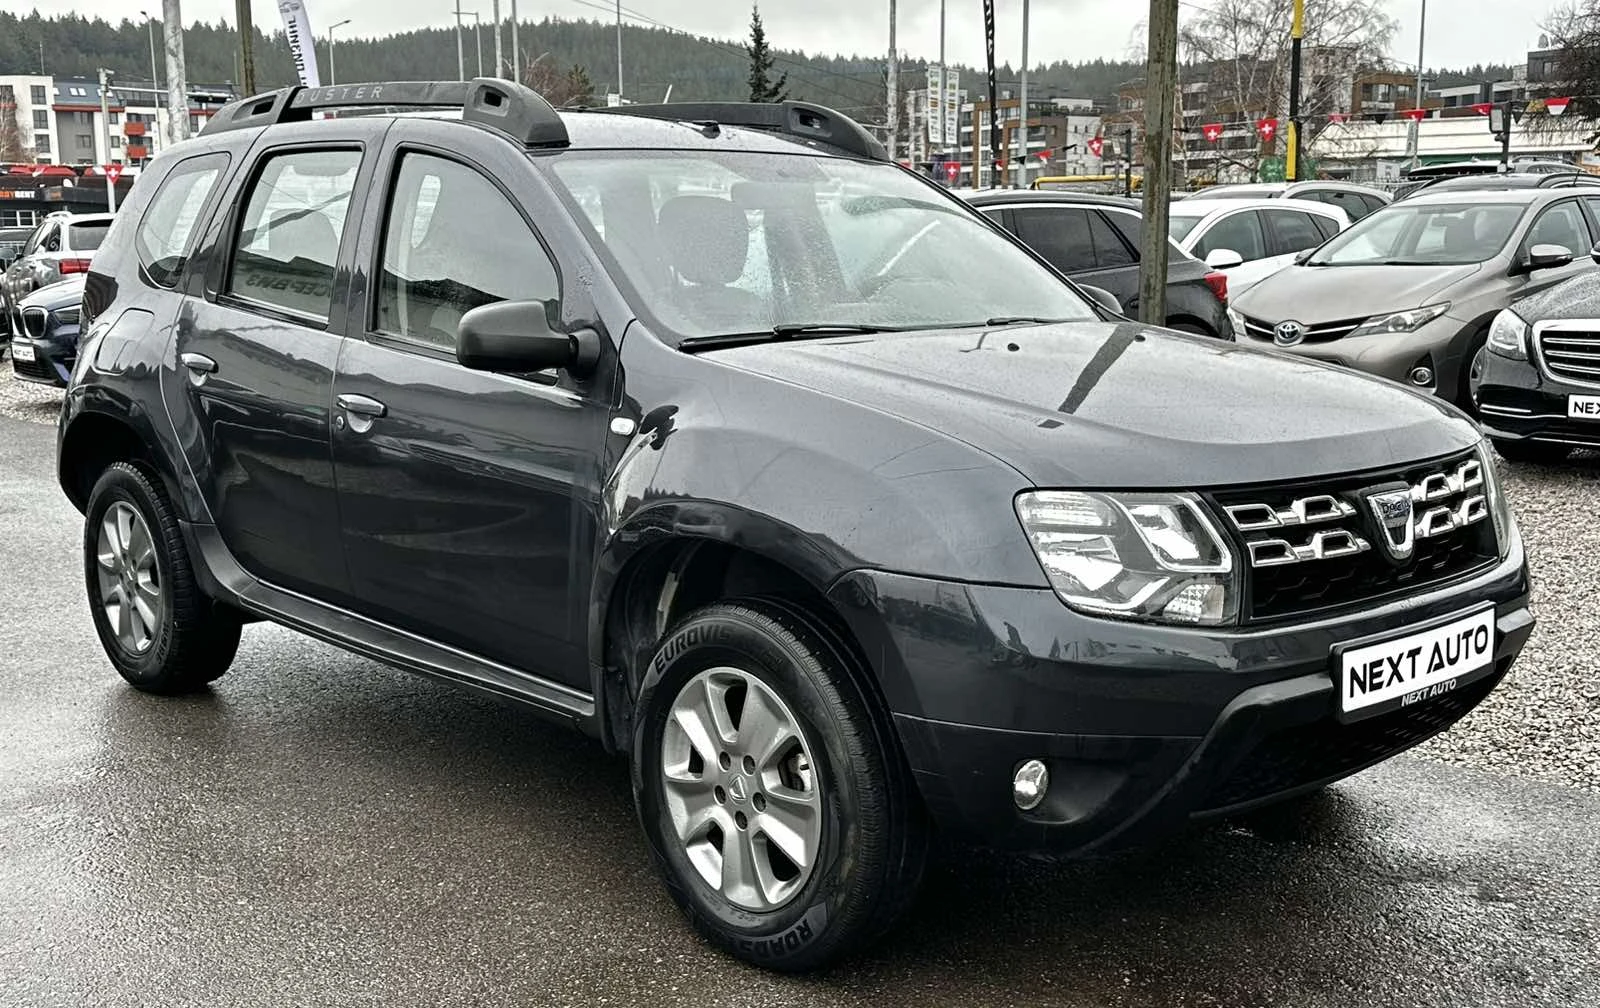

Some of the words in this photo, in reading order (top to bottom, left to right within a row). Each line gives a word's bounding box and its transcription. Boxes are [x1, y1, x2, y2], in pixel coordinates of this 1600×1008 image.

[293, 86, 383, 104] DUSTER
[1349, 646, 1423, 698] NEXT
[1426, 624, 1488, 674] AUTO
[1401, 687, 1429, 707] NEXT
[1429, 678, 1457, 697] AUTO
